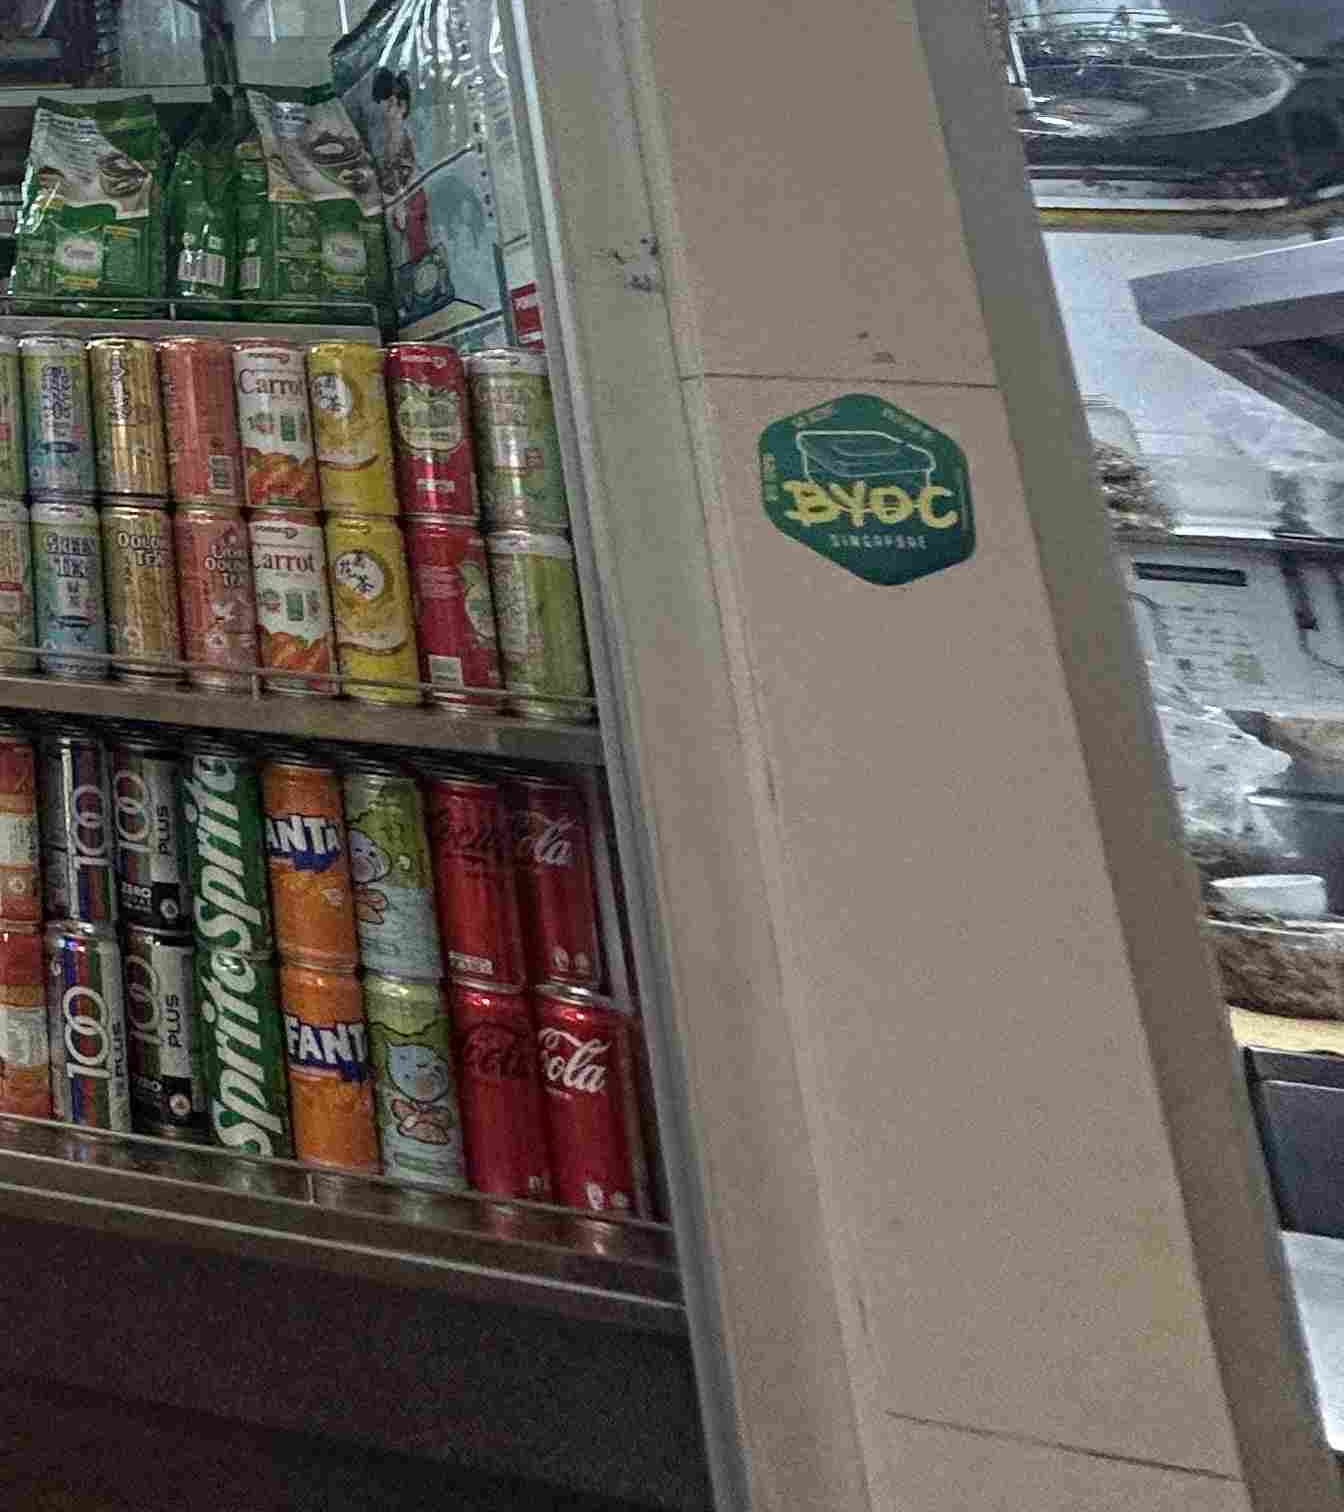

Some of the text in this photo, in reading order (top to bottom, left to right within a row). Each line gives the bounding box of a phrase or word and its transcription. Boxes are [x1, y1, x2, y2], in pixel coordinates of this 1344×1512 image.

[157, 804, 171, 857] PLUS
[184, 754, 265, 955] Sprite
[63, 985, 112, 1079] 100
[167, 994, 181, 1049] PLUS
[203, 954, 284, 1157] Sprite
